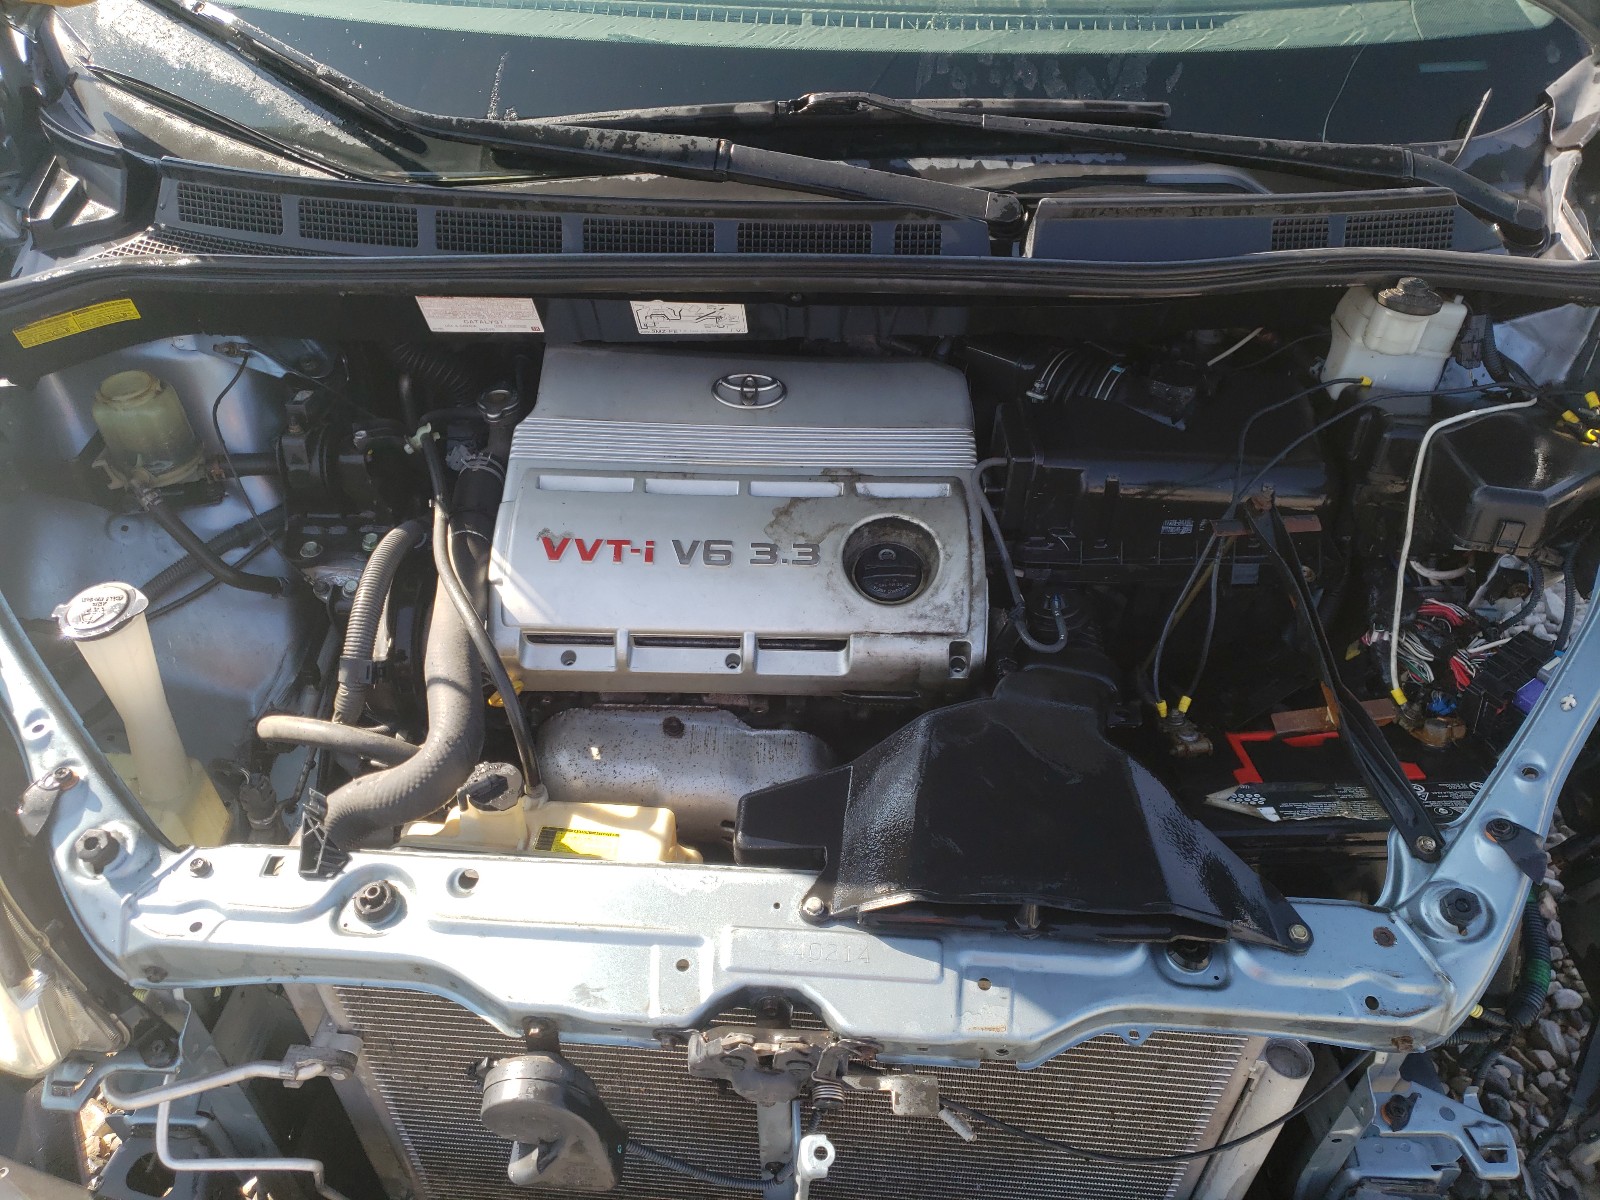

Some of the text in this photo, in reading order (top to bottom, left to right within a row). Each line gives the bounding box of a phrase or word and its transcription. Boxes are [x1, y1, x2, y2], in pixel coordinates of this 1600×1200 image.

[541, 537, 821, 567] VVT-i V6 3.3
[793, 942, 871, 964] 40214
